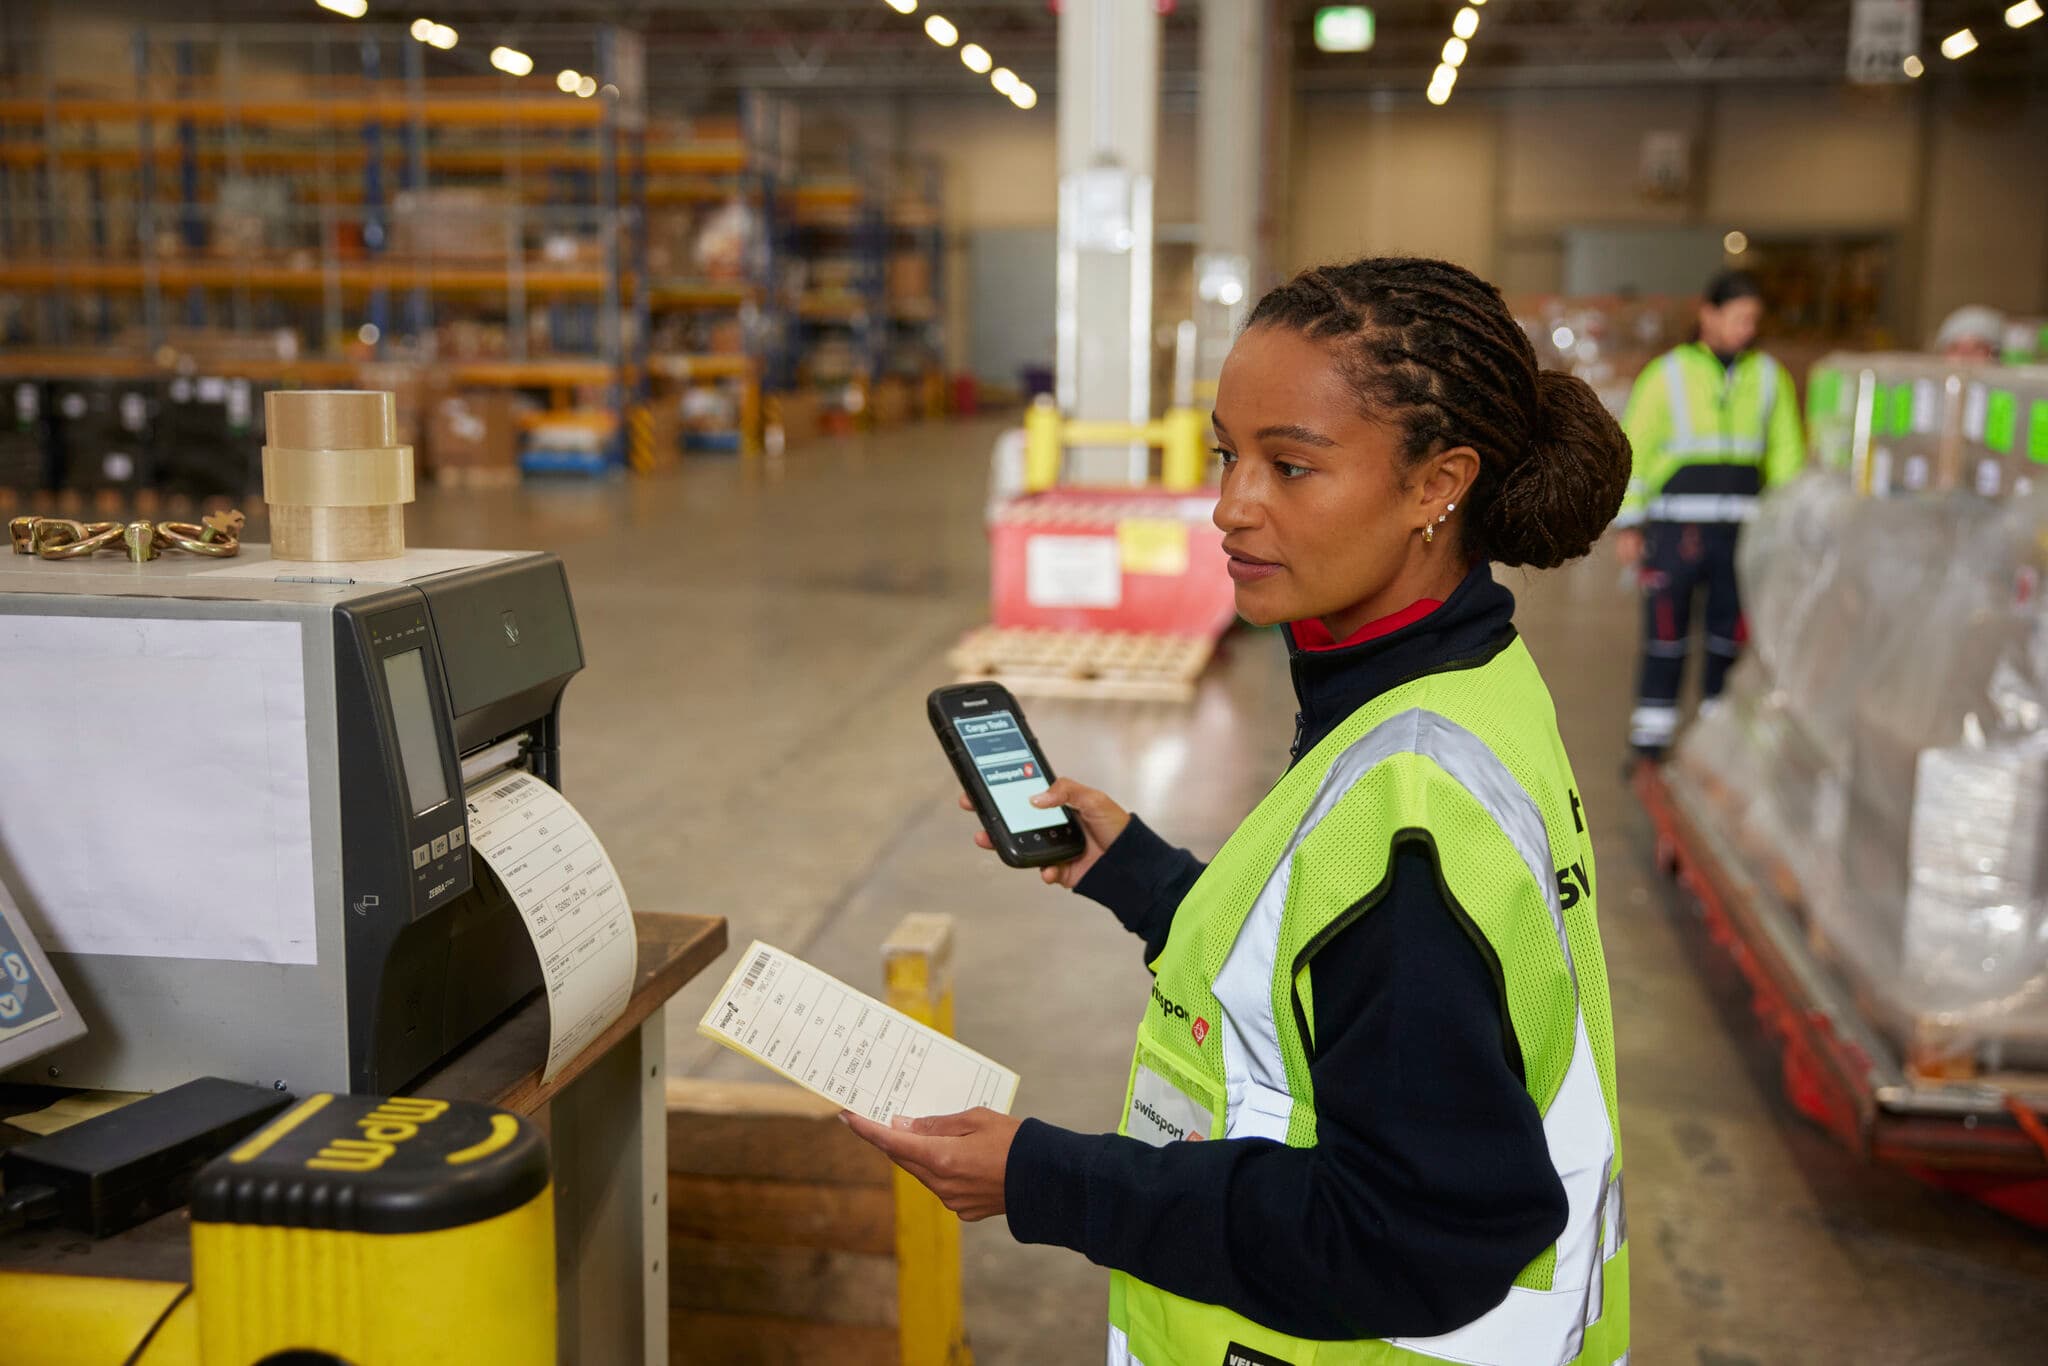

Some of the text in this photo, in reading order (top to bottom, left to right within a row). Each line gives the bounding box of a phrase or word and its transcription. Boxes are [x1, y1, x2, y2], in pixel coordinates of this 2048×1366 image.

[965, 724, 988, 733] Cargo
[428, 884, 445, 899] ZEBRA
[1134, 1098, 1184, 1141] swissport
[1229, 1354, 1265, 1366] VE
